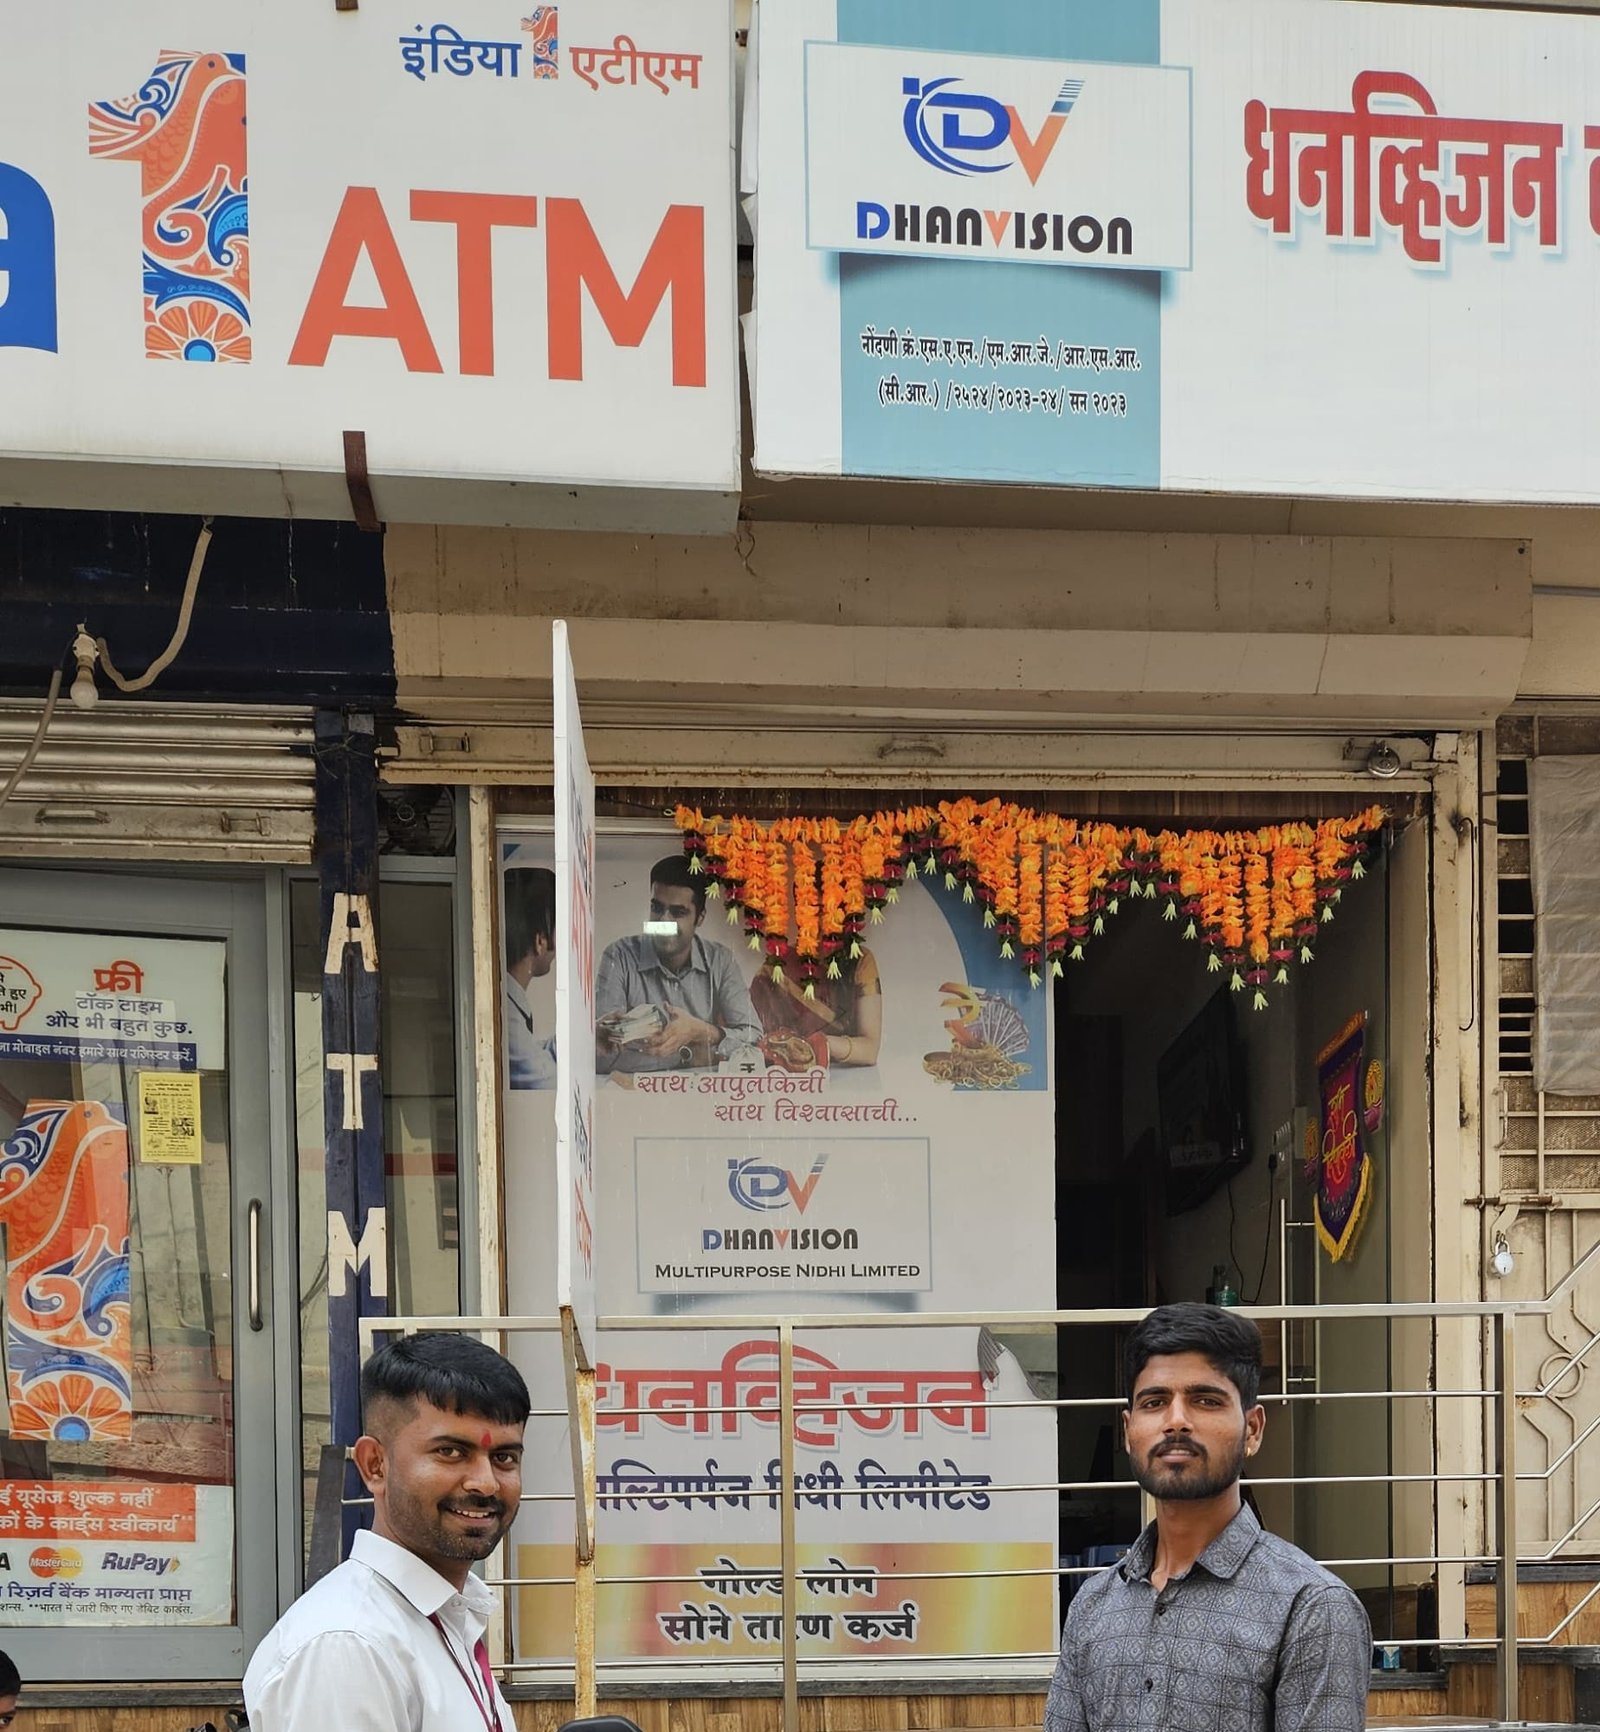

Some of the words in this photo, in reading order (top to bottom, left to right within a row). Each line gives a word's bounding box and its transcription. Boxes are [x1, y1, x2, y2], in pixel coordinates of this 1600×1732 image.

[399, 24, 522, 81] इंडिया
[569, 34, 703, 95] एटीएम
[1244, 70, 1564, 262] धनव्हिजन
[856, 201, 1133, 255] DHANVISION
[287, 185, 707, 388] ATM
[861, 327, 899, 358] नोंदणी
[878, 374, 941, 409] (सी.आर.)
[1068, 391, 1089, 413] सन
[1092, 394, 1128, 415] २०२३
[94, 960, 144, 993] फ्री
[76, 993, 114, 1010] टॉक
[119, 1000, 163, 1016] टाइम
[46, 1011, 79, 1029] और
[86, 1013, 104, 1030] भी
[110, 1018, 149, 1036] बहुत
[153, 1020, 193, 1038] कुछ.
[12, 1039, 51, 1056] मोबाइल
[53, 1041, 76, 1056] नंबर
[79, 1043, 104, 1058] हमारे
[107, 1047, 128, 1059] साथ
[129, 1047, 170, 1061] रजिस्टर
[637, 1075, 689, 1094] साथ
[697, 1069, 827, 1101] आपुलकिची
[714, 1104, 766, 1122] साथ
[702, 1228, 859, 1251] DHANVISION
[655, 1264, 791, 1278] MULTIPURPOSE
[796, 1263, 846, 1278] NIDHI
[851, 1263, 921, 1277] LIMITED
[16, 1484, 64, 1510] यूसेज
[68, 1489, 115, 1511] शुल्क
[855, 1458, 993, 1512] लिमीटेड
[24, 1510, 45, 1530] के
[30, 1557, 83, 1568] MasterCard
[101, 1551, 170, 1576] RuPay
[802, 1558, 876, 1594] लोन
[58, 1582, 91, 1599] बैंक
[95, 1587, 154, 1600] मान्यता
[158, 1588, 192, 1604] प्राप्त
[660, 1603, 732, 1641] सोने
[842, 1603, 916, 1640] कर्ज
